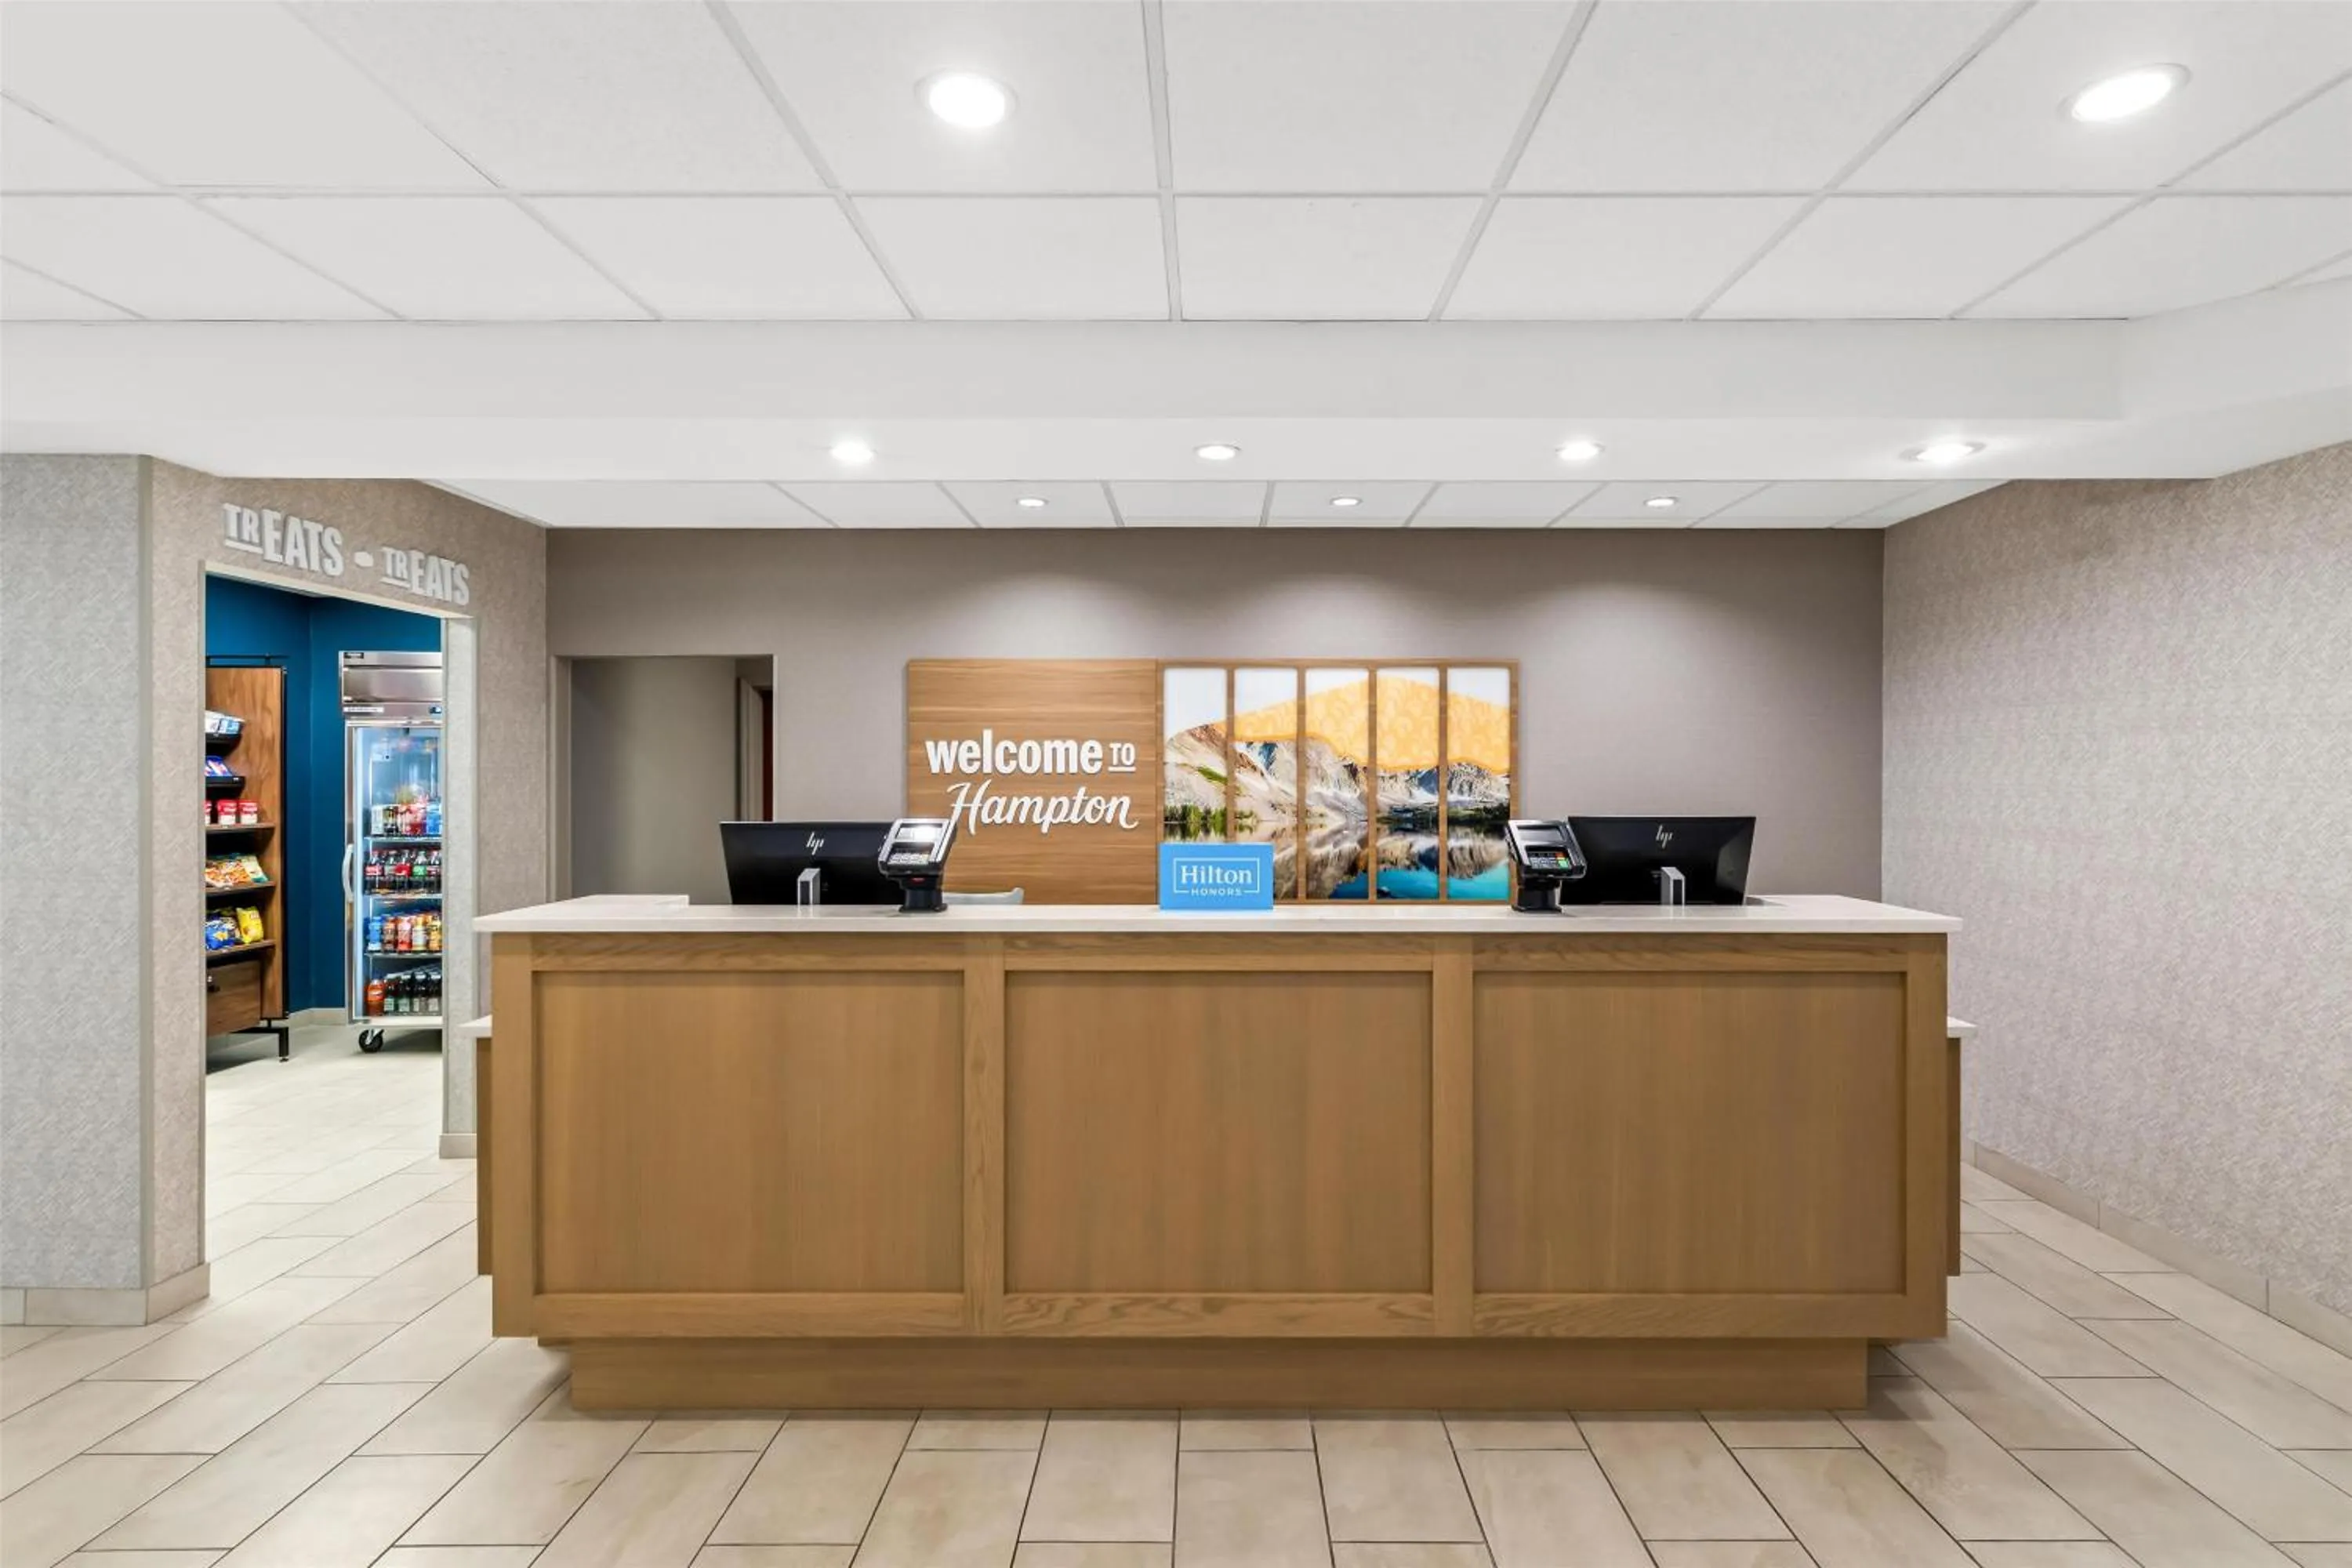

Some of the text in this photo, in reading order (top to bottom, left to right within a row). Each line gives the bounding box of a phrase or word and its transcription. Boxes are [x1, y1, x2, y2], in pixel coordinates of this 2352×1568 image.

[224, 504, 470, 605] TREATS TREATS
[926, 729, 1136, 774] welcome TO
[947, 779, 1138, 835] Hampton
[807, 832, 824, 855] hp
[1181, 865, 1252, 884] Hilton
[1191, 887, 1243, 896] HONORS
